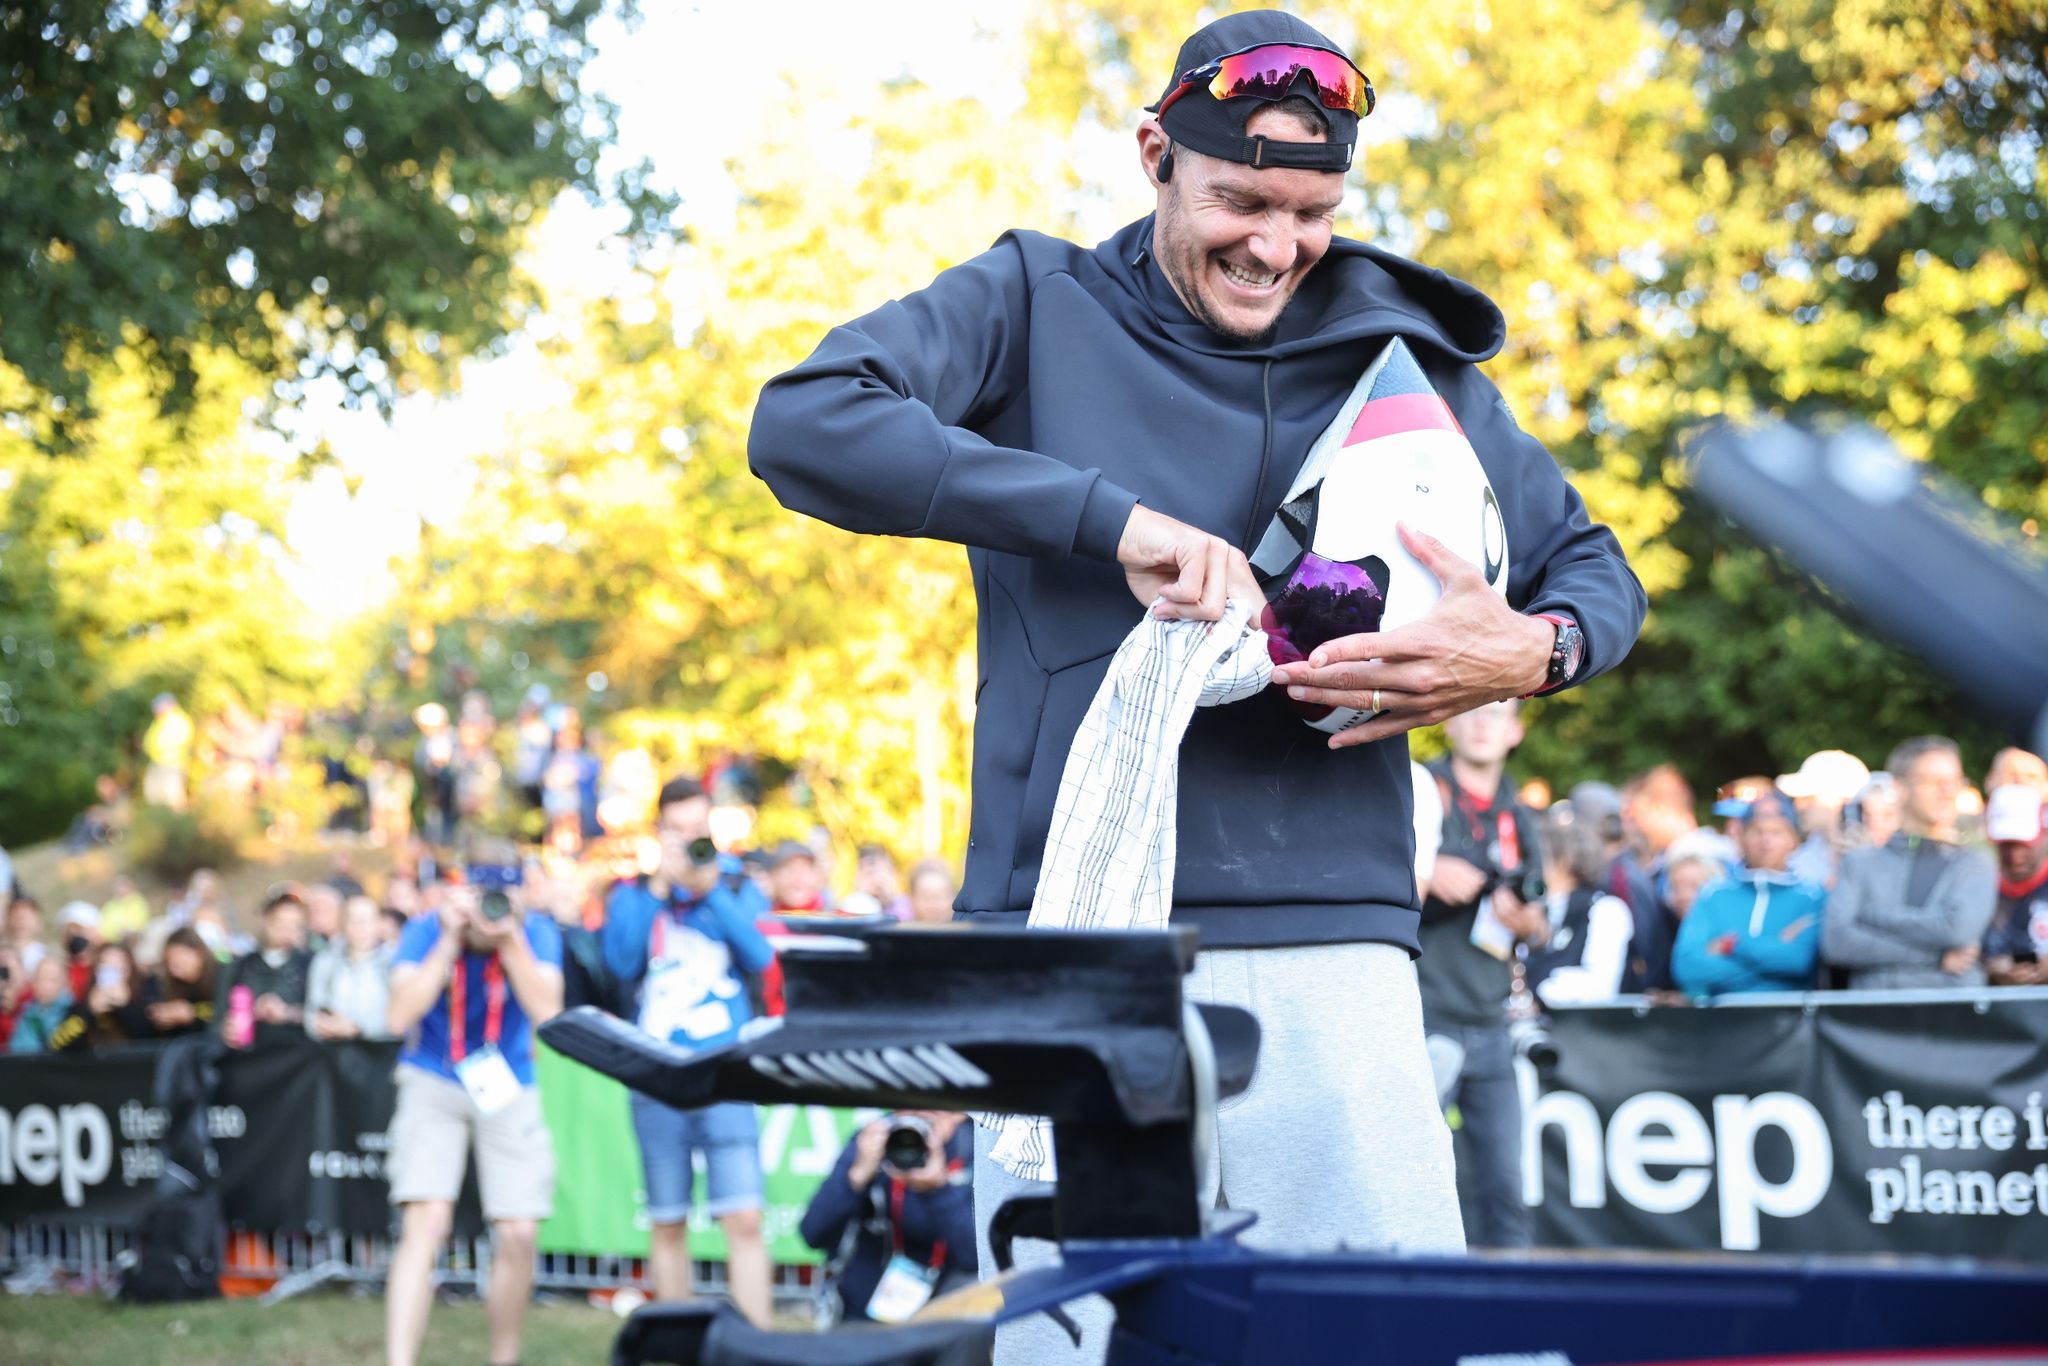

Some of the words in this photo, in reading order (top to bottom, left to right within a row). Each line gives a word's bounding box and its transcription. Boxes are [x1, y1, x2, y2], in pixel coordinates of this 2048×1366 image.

[1514, 1057, 1834, 1251] hep
[1862, 1090, 2017, 1151] there
[2023, 1091, 2048, 1150] i
[1865, 1154, 2048, 1224] planet
